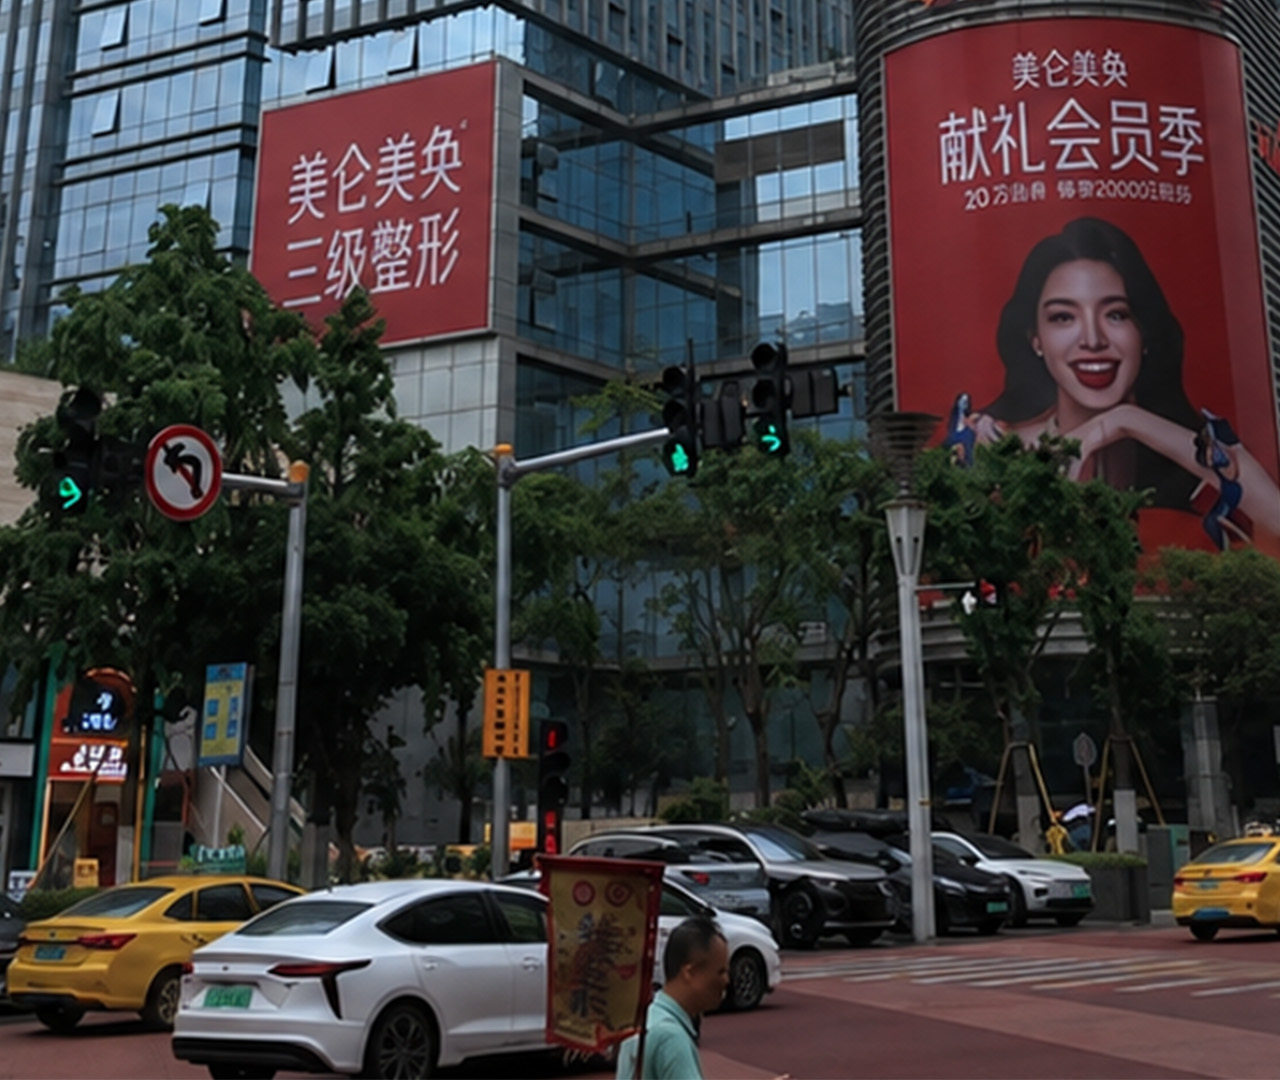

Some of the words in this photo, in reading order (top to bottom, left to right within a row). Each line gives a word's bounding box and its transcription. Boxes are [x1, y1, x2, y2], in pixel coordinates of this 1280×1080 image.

[1012, 48, 1128, 91] 美仑美奂
[287, 124, 463, 225] 美仑美奂
[938, 96, 1205, 185] 献礼会员季
[282, 206, 460, 308] 三级整形
